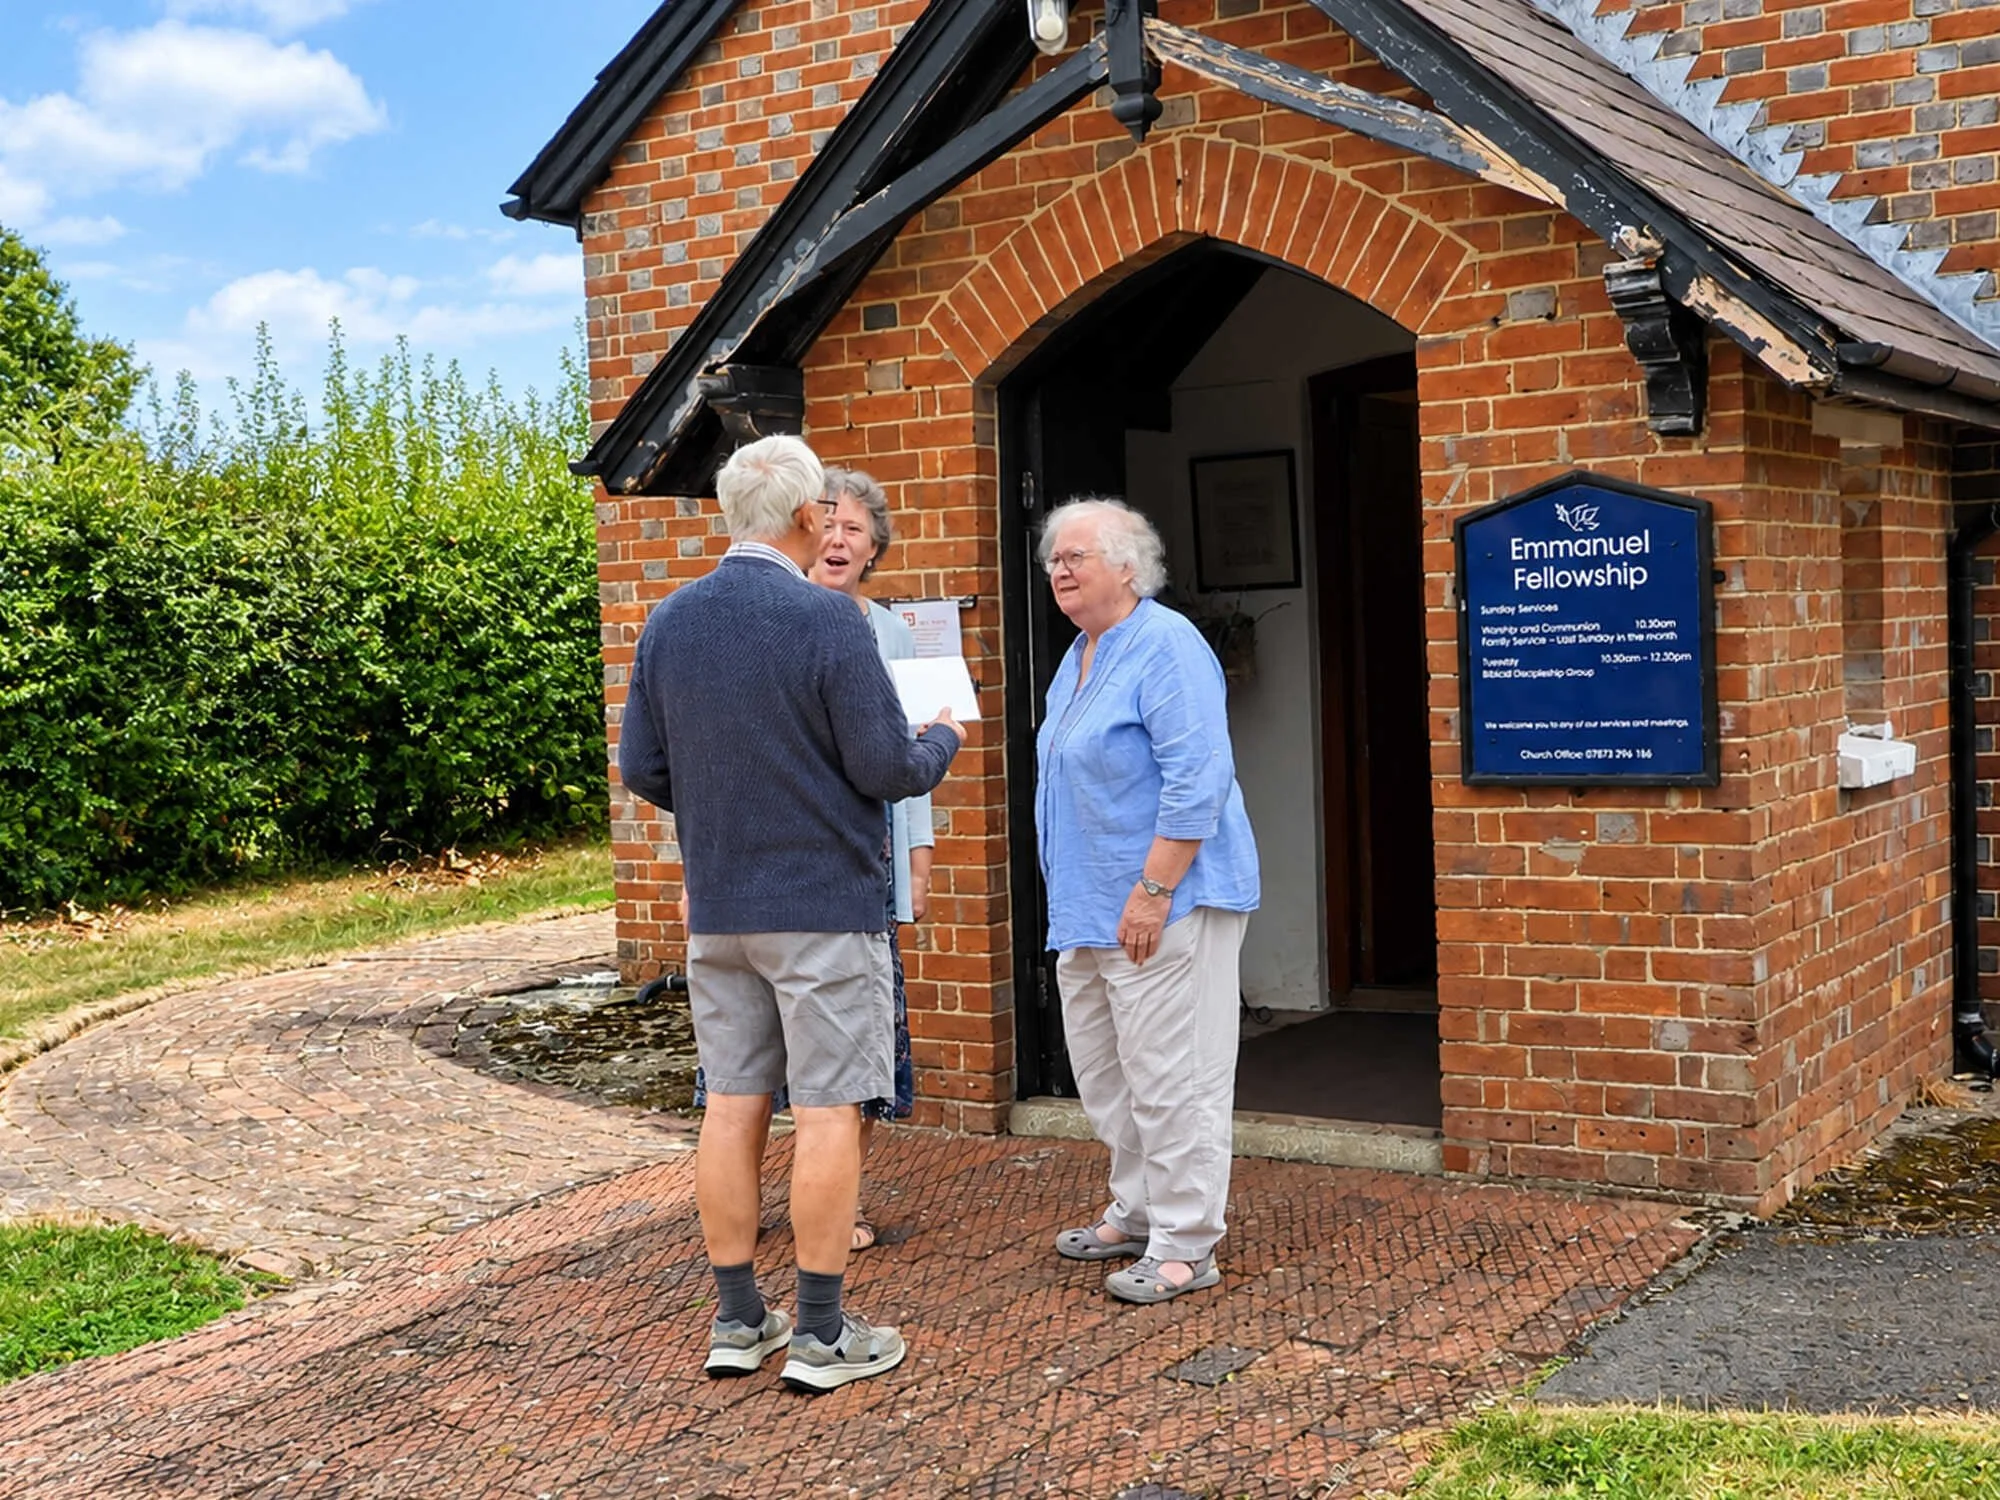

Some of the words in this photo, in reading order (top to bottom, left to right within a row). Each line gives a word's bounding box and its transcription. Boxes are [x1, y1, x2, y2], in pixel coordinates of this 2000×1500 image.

[1511, 528, 1650, 561] Emmanuel
[1514, 561, 1648, 591] Fellowship
[1481, 605, 1516, 616] Sunday
[1518, 603, 1559, 613] Services
[1481, 625, 1518, 635] Worship
[1520, 624, 1540, 634] and
[1541, 621, 1600, 633] Communion
[1635, 618, 1677, 629] 10.30am
[1481, 636, 1511, 648] Family
[1512, 636, 1547, 646] Service
[1556, 634, 1577, 645] Last
[1578, 633, 1615, 644] Sunday
[1616, 632, 1626, 642] in
[1627, 632, 1644, 641] the
[1646, 630, 1678, 641] month
[1600, 653, 1641, 664] 10.30am
[1650, 651, 1692, 663] 12.30pm
[1482, 669, 1512, 679] Biblical
[1513, 668, 1565, 679] Discipleship
[1565, 667, 1595, 678] Group
[1484, 721, 1497, 730] We
[1498, 721, 1533, 730] welcome
[1534, 722, 1549, 731] you
[1549, 721, 1558, 729] to
[1559, 720, 1574, 730] any
[1575, 720, 1584, 729] of
[1584, 720, 1599, 728] our
[1600, 719, 1631, 729] services
[1632, 719, 1649, 728] and
[1520, 749, 1553, 760] Church
